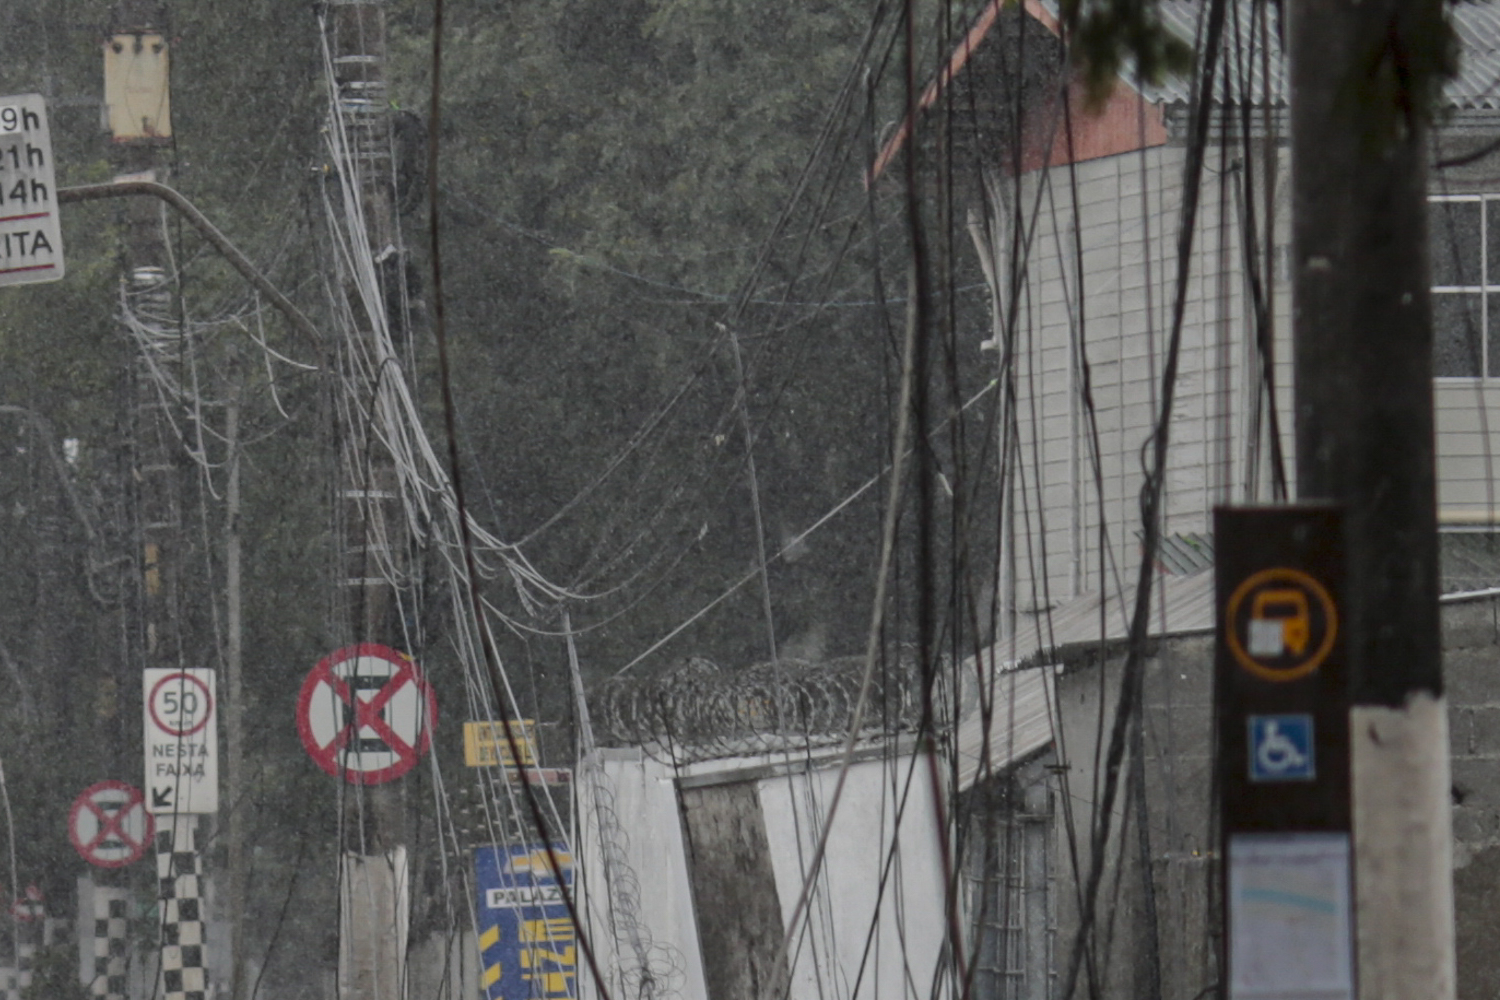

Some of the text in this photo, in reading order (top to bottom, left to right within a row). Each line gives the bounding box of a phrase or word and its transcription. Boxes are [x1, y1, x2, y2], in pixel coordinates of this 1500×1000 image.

[163, 691, 198, 715] 50
[152, 743, 209, 758] NESTA
[156, 763, 206, 778] FAXA
